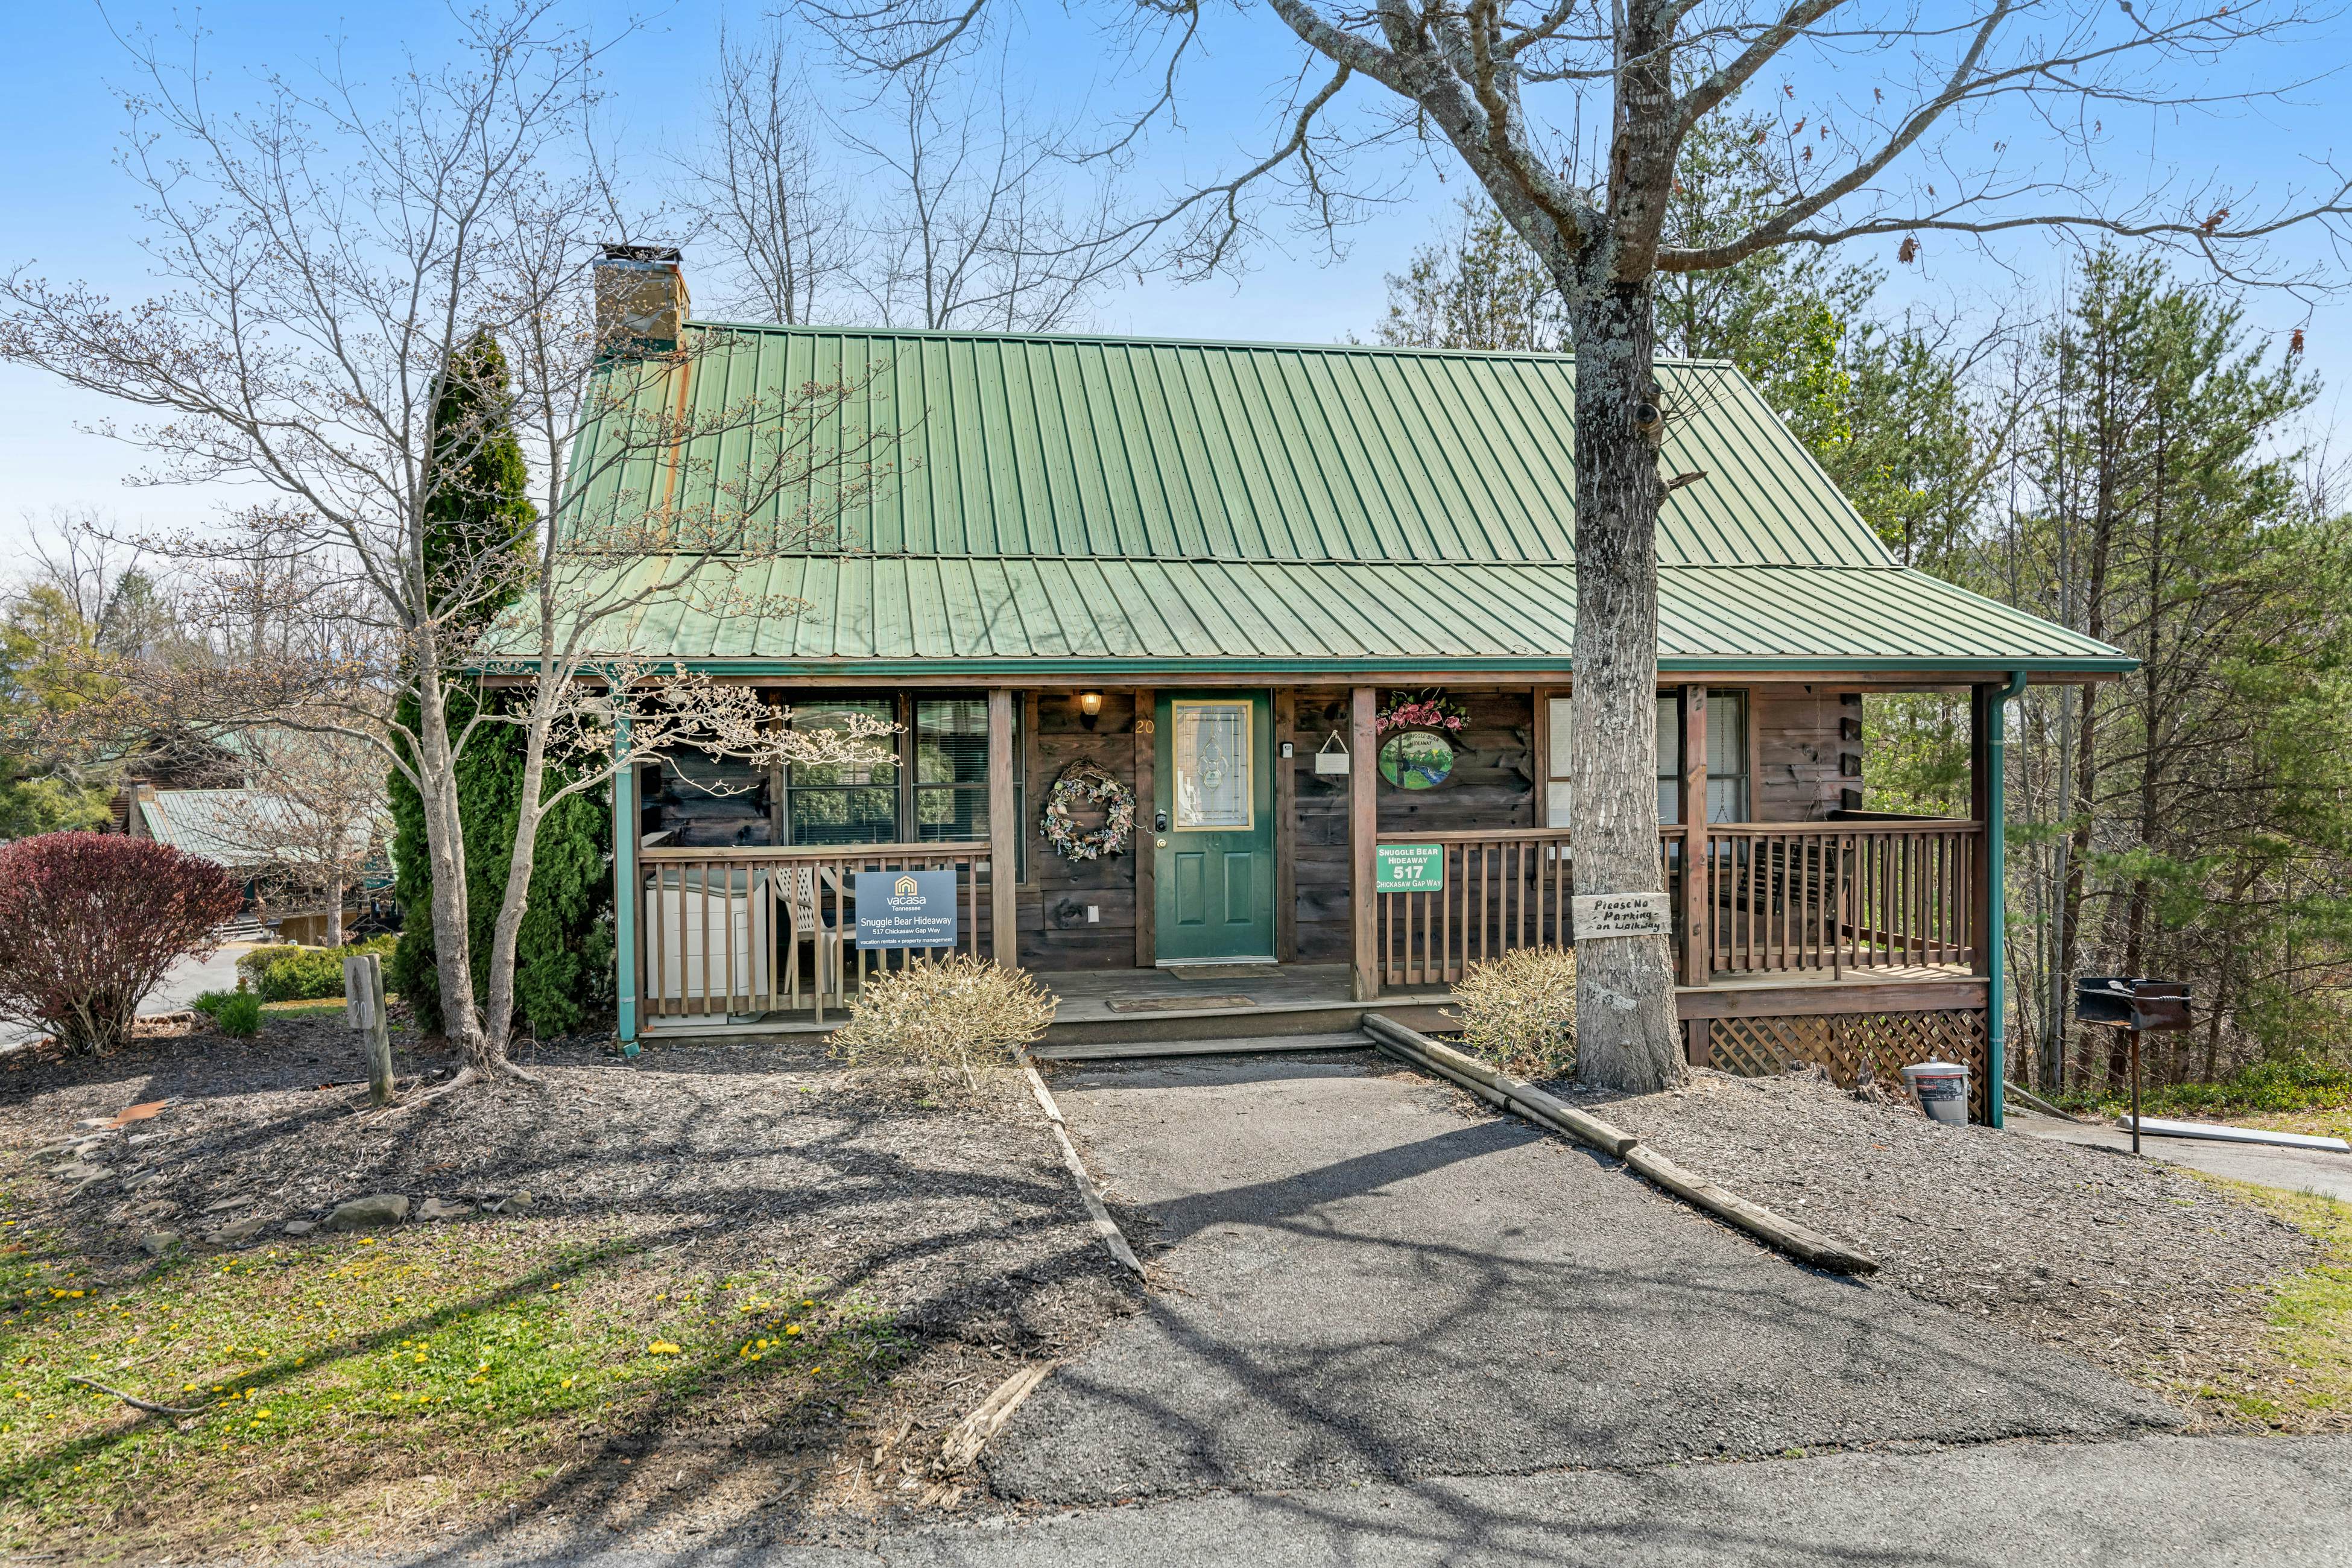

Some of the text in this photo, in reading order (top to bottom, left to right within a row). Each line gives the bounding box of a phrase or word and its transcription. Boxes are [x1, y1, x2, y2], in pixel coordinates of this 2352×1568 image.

[1135, 720, 1154, 734] 20
[1393, 866, 1423, 879] 517
[886, 896, 926, 905] vacasa
[1594, 900, 1631, 911] Please
[861, 916, 952, 928] Snuggle Bear Hideaway
[1603, 911, 1652, 921] Parking
[352, 1001, 367, 1023] 20
